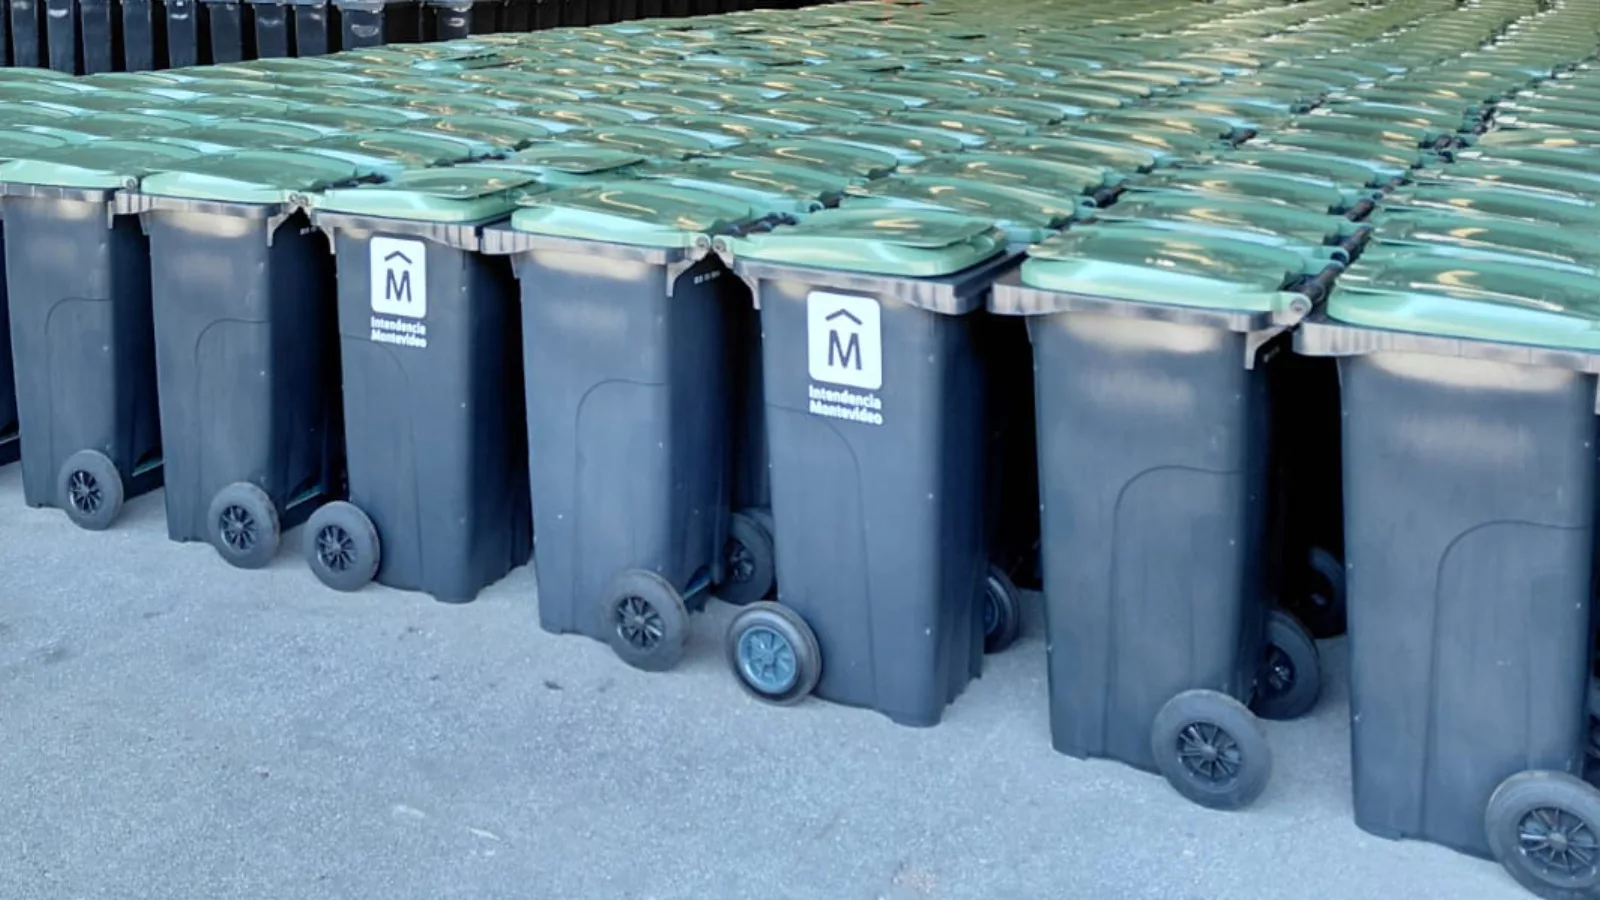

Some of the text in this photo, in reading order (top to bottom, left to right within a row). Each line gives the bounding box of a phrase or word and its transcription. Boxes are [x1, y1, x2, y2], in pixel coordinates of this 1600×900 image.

[385, 268, 412, 302] M
[370, 315, 427, 335] Intendencia
[370, 328, 427, 348] Montevideo
[828, 329, 863, 370] M
[808, 384, 882, 410] Intendencia
[808, 399, 883, 425] Montevideo
